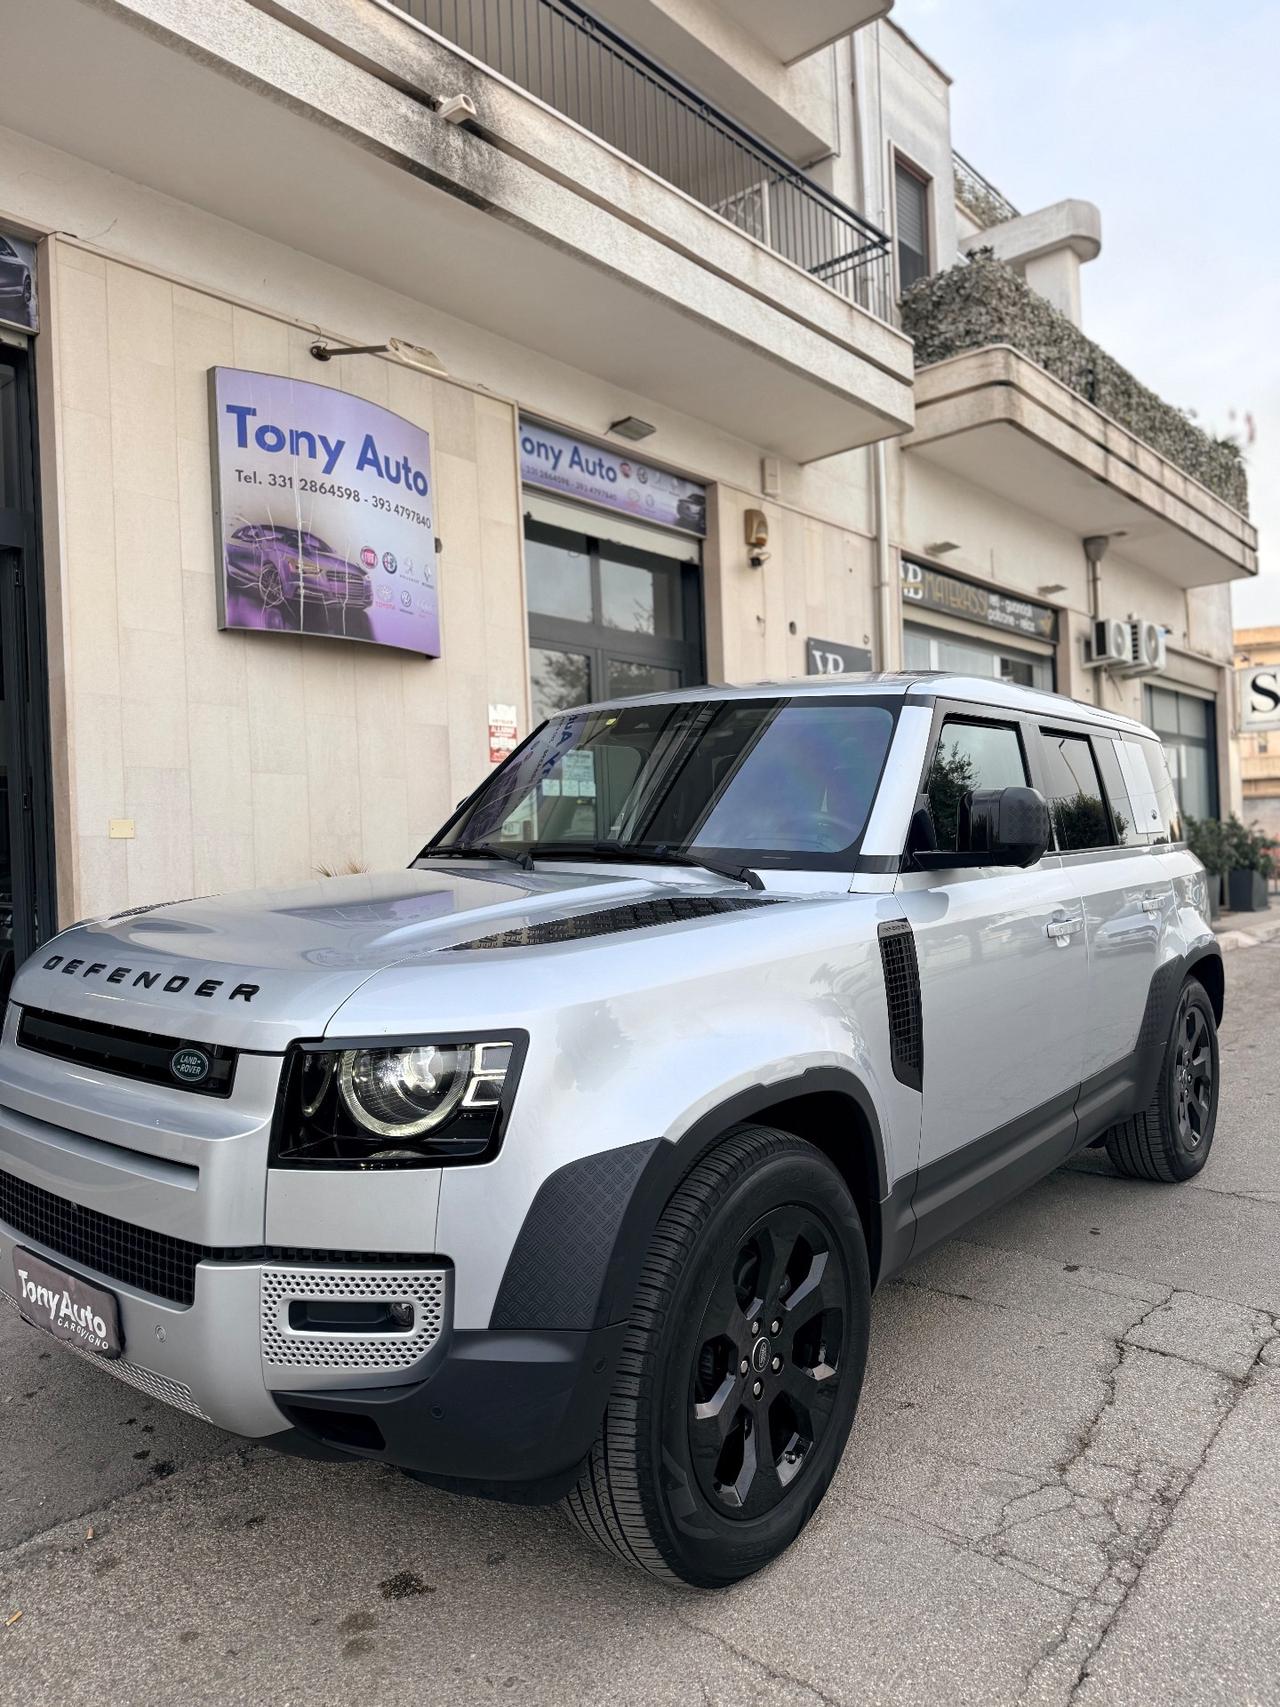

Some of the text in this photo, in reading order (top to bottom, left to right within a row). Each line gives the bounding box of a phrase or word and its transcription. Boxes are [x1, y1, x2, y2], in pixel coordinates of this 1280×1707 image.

[226, 404, 428, 497] Tony Auto
[520, 430, 618, 483] ony Auto
[234, 469, 262, 485] Tel.
[268, 473, 294, 489] 331
[299, 477, 360, 503] 2864598
[372, 495, 392, 512] 393
[394, 503, 431, 529] 4797840
[43, 955, 261, 1003] DEFENDER
[180, 1055, 198, 1065] LAND
[180, 1064, 201, 1075] ROVER
[57, 1318, 109, 1350] CAROVIGNO
